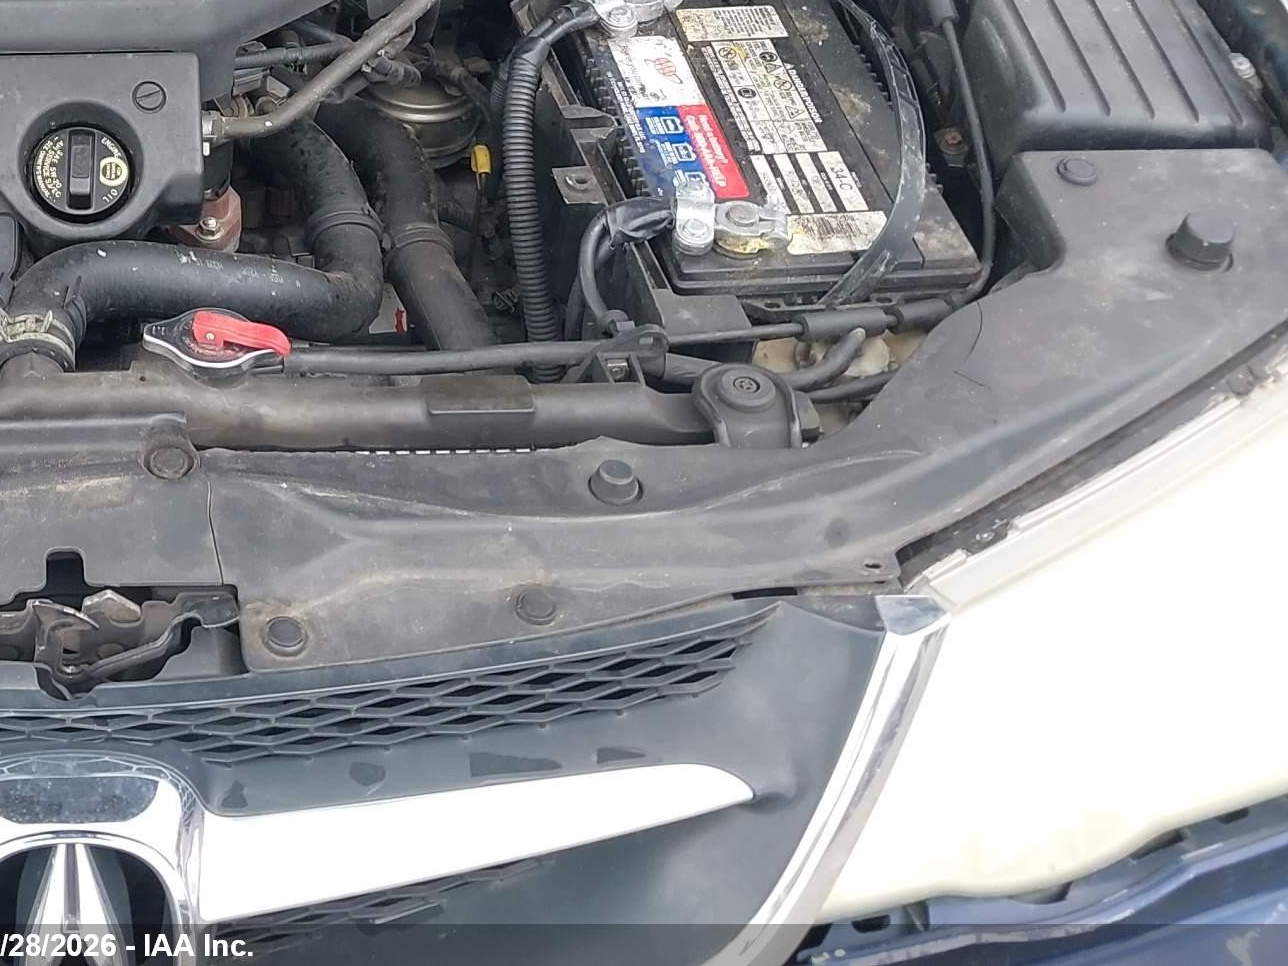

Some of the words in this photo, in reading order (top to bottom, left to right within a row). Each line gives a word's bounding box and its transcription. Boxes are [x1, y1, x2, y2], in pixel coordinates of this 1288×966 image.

[101, 137, 122, 160] ENGINE
[42, 149, 55, 178] SERVICE
[830, 166, 853, 191] 34-C
[102, 188, 119, 203] OIL
